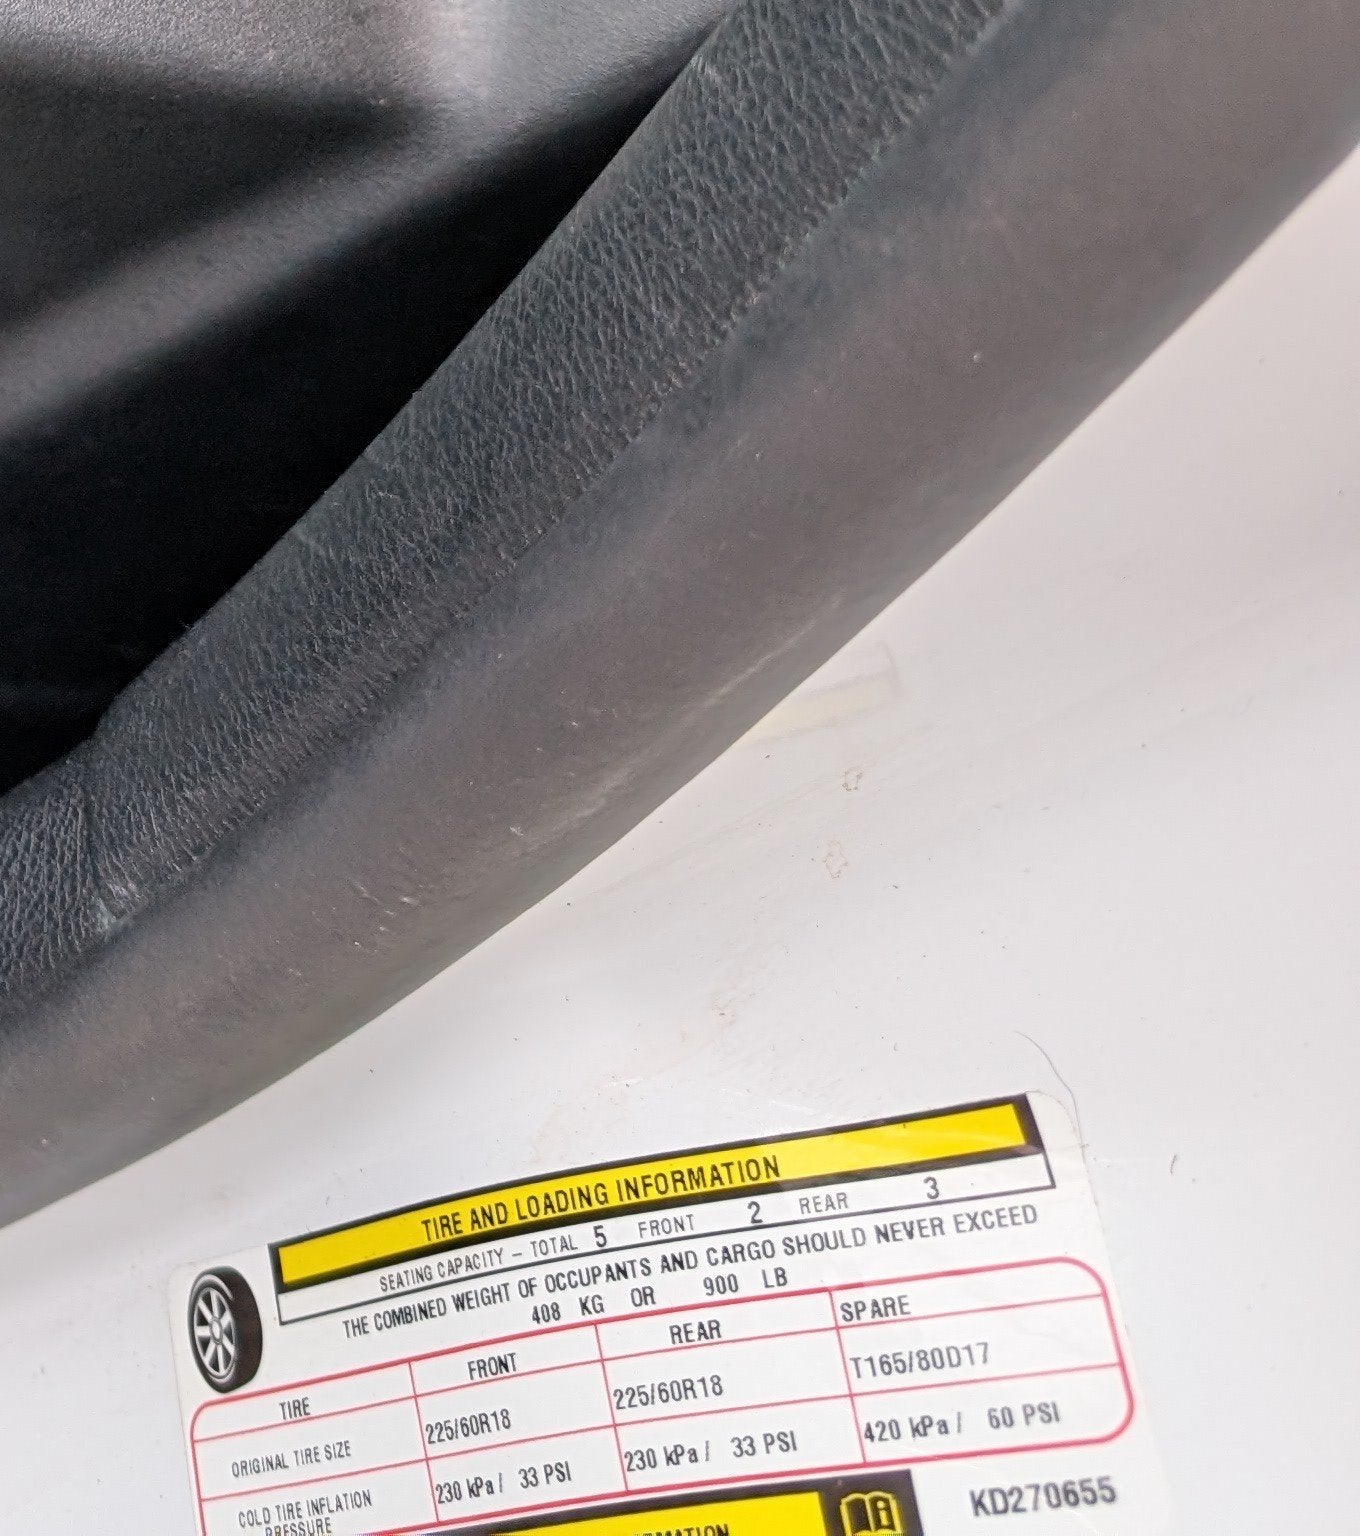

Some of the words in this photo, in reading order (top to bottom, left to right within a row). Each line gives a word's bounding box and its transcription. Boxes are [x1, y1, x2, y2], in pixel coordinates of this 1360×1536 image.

[421, 1211, 463, 1241] TIRE
[471, 1202, 508, 1230] AND
[515, 1182, 608, 1220] LOADING
[616, 1155, 780, 1202] INFORMATION
[380, 1266, 432, 1292] SEATING
[437, 1247, 503, 1277] CAPACITY
[530, 1234, 578, 1258] TOTAL
[593, 1225, 607, 1248] 5
[638, 1214, 694, 1238] FRONT
[747, 1201, 762, 1224] 2
[799, 1192, 848, 1214] REAR
[923, 1177, 940, 1200] 3
[343, 1318, 369, 1338] THE
[374, 1297, 447, 1331] COMBINED
[451, 1283, 510, 1312] WEIGHT
[518, 1277, 538, 1298] OF
[545, 1258, 651, 1293] OCCUPANTS
[661, 1250, 698, 1274] AND
[706, 1239, 775, 1266] CARGO
[783, 1227, 866, 1256] SHOULD
[874, 1216, 945, 1243] NEVER
[953, 1204, 1038, 1233] EXCEED
[531, 1302, 561, 1324] 408
[579, 1294, 605, 1316] KG
[630, 1285, 656, 1307] OR
[703, 1274, 739, 1296] 900
[762, 1267, 788, 1289] LB
[840, 1295, 911, 1322] SPARE
[669, 1319, 722, 1344] REAR
[467, 1352, 518, 1380] FRONT
[849, 1342, 989, 1379] T165/80D17
[279, 1397, 311, 1420] TIRE
[613, 1374, 723, 1410] 225/60R18
[425, 1408, 512, 1445] 225/60R18
[864, 1419, 901, 1443] 420
[988, 1406, 1014, 1430] 60
[1023, 1401, 1061, 1425] PSI
[231, 1454, 289, 1478] ORIGINAL
[293, 1446, 320, 1466] TIRE
[323, 1440, 351, 1460] SIZE
[624, 1448, 658, 1472] 230
[730, 1435, 756, 1457] 33
[763, 1430, 798, 1454] PSI
[435, 1482, 462, 1504] 230
[518, 1466, 539, 1489] 33
[544, 1461, 572, 1485] PSI
[969, 1475, 1116, 1517] KD270655
[238, 1507, 270, 1528] COLD
[275, 1501, 303, 1521] TIRE
[306, 1489, 372, 1517] INFLATION
